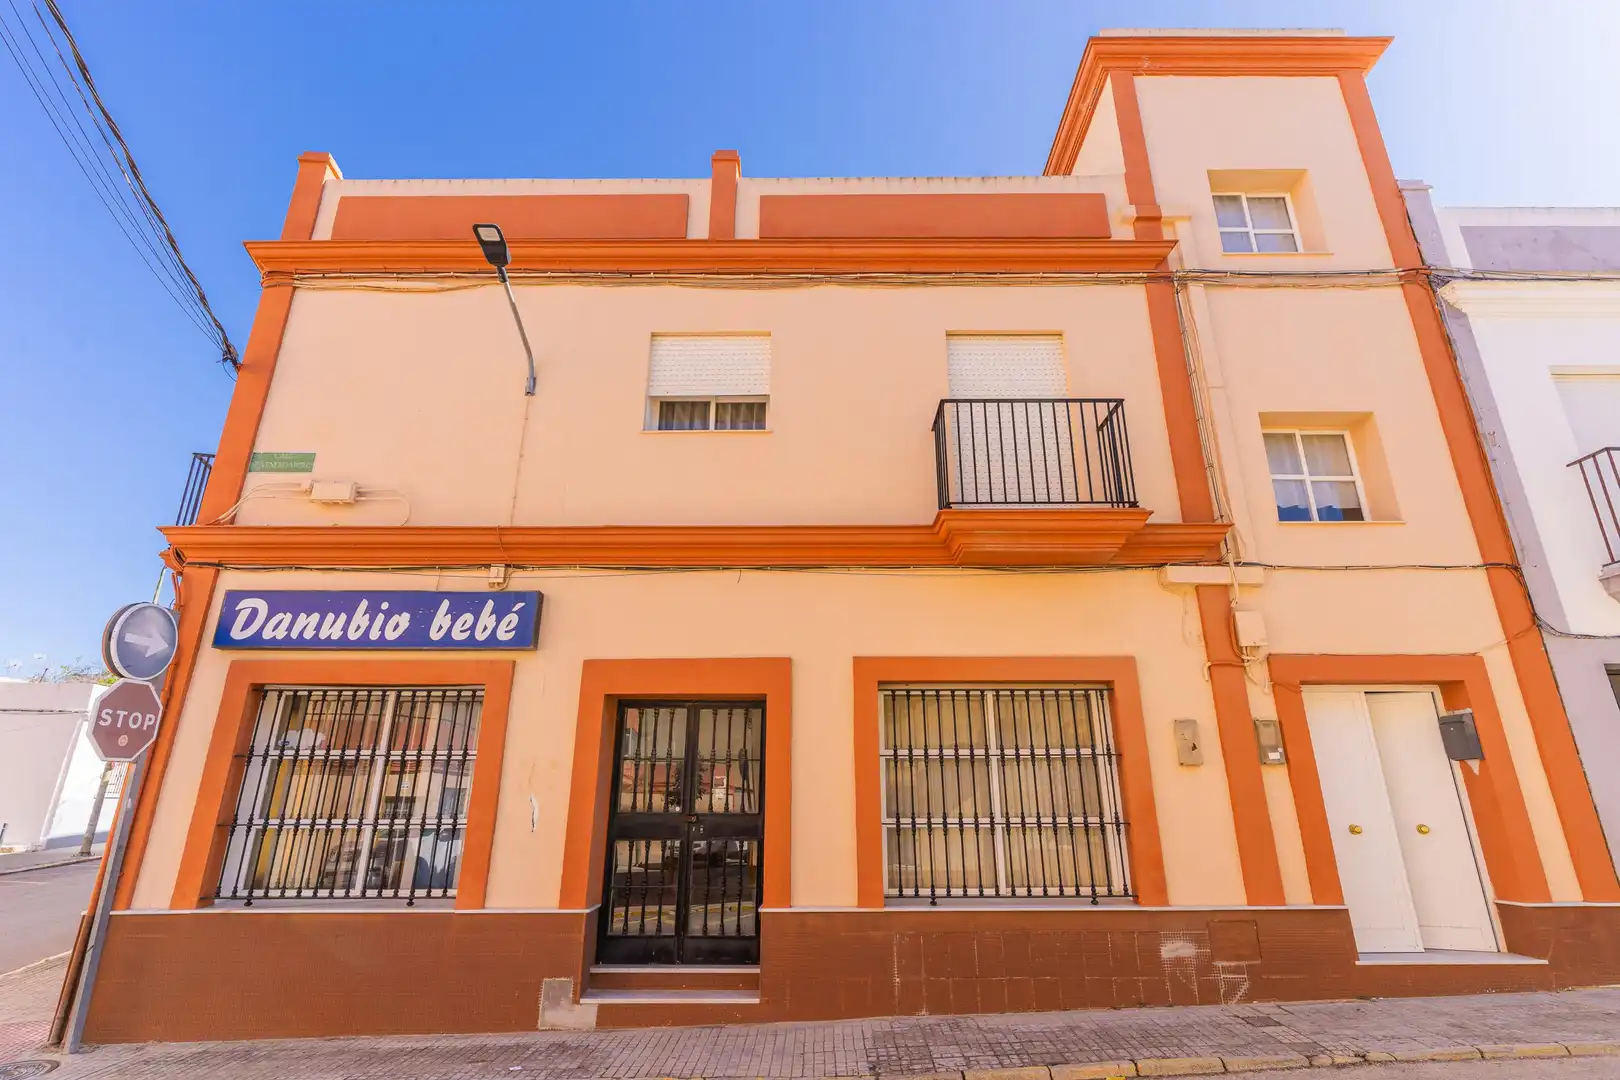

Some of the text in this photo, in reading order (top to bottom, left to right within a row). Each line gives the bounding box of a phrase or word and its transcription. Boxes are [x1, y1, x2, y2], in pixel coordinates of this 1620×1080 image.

[230, 598, 526, 641] Danubio bebé
[98, 708, 156, 731] STOP
